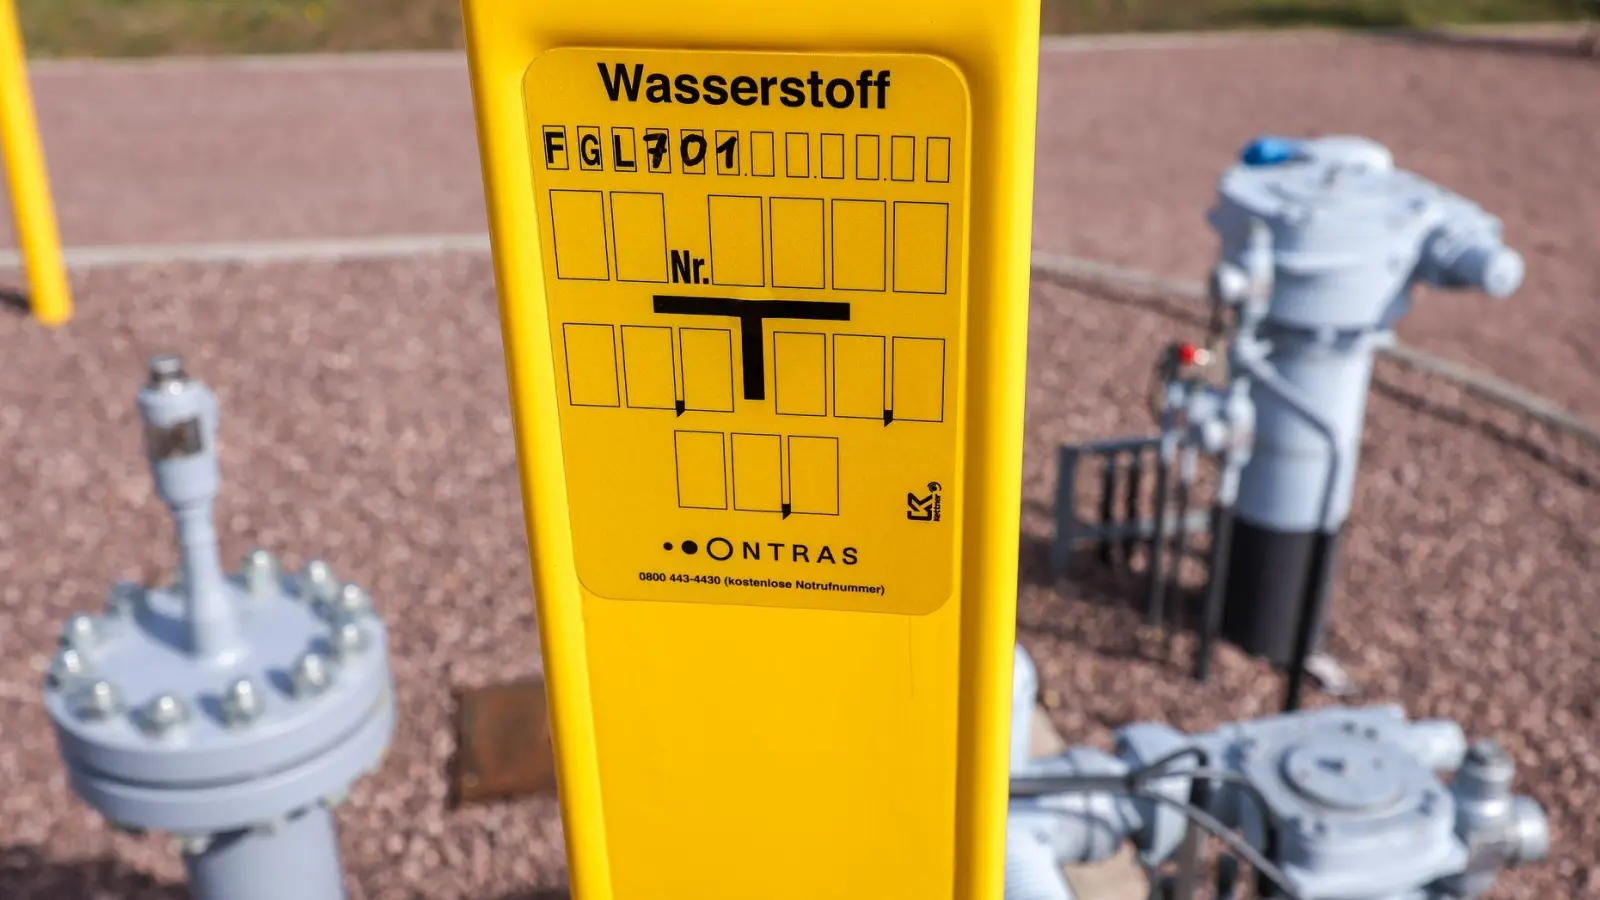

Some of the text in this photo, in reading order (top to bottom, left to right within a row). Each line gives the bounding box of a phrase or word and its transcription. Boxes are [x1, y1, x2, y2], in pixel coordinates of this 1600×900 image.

[597, 63, 891, 109] Wasserstoff
[671, 249, 709, 284] Nr.
[706, 537, 859, 566] ONTRAS
[638, 571, 886, 597] 0800 443-4430 (kostenlose Notrufnummer)
